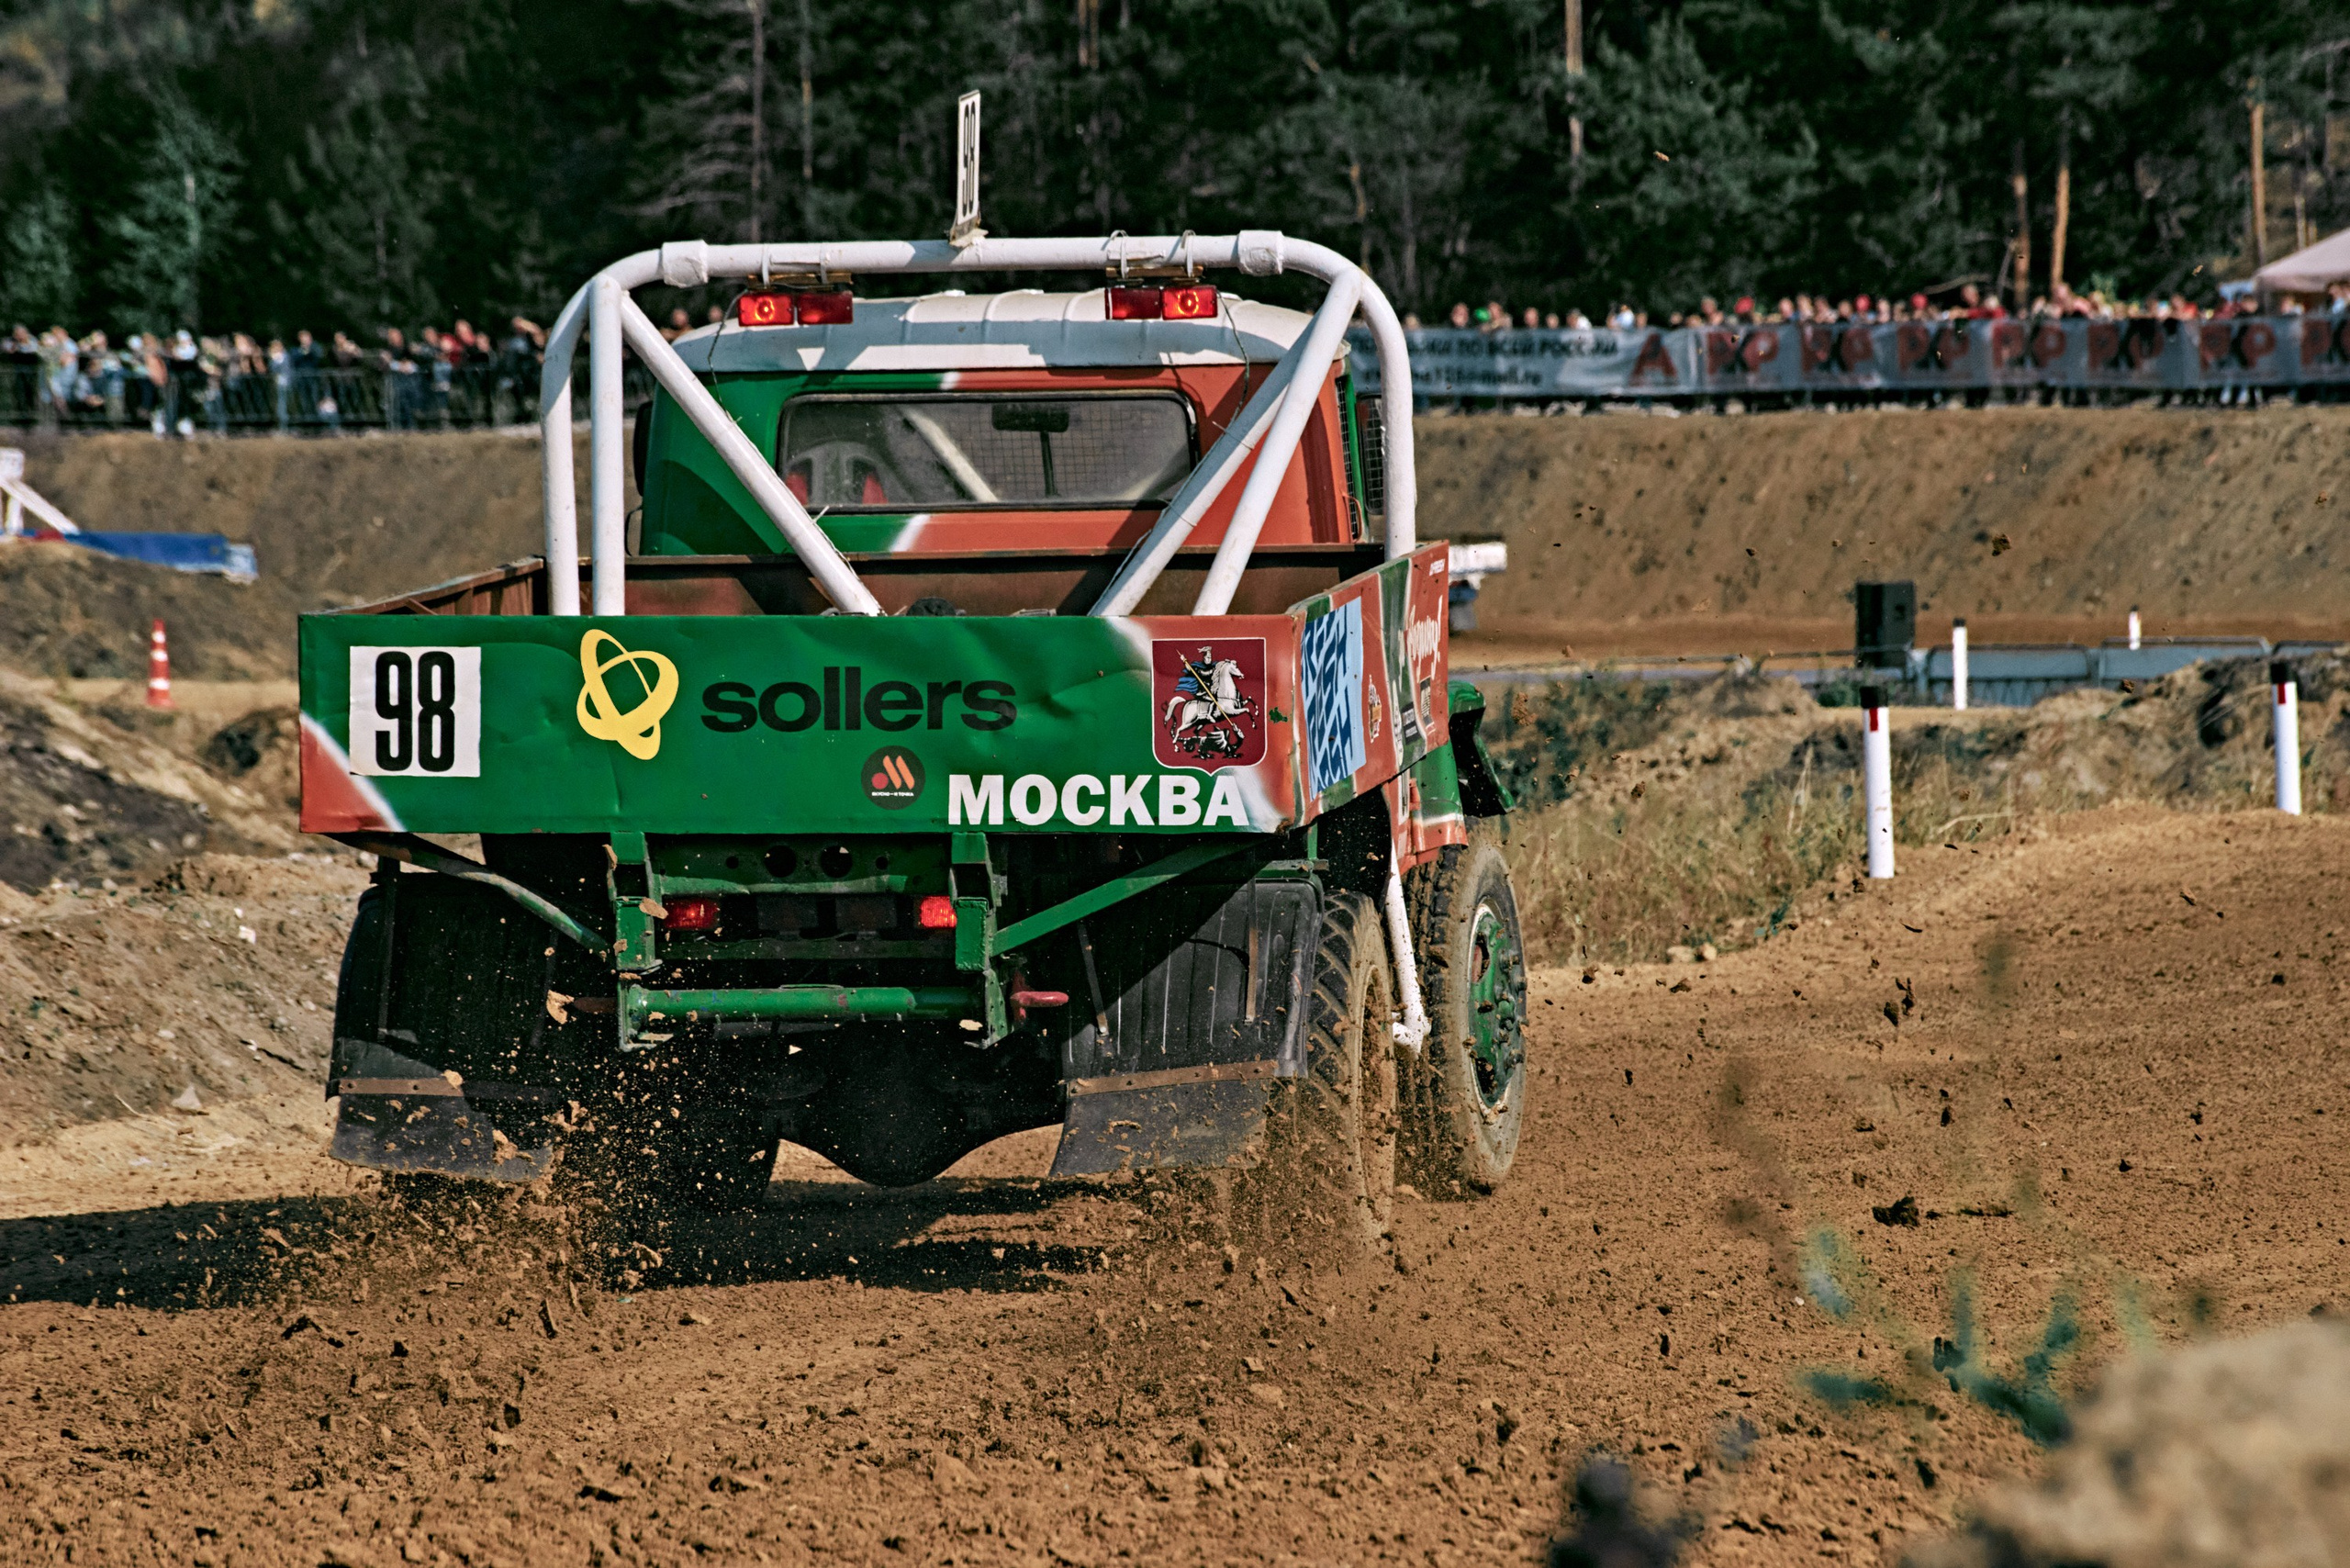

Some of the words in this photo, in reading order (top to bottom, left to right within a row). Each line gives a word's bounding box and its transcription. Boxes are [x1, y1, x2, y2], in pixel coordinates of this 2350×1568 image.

[375, 650, 456, 772] 98
[700, 666, 1018, 734] sollers
[947, 773, 1250, 827] МОСКВА
